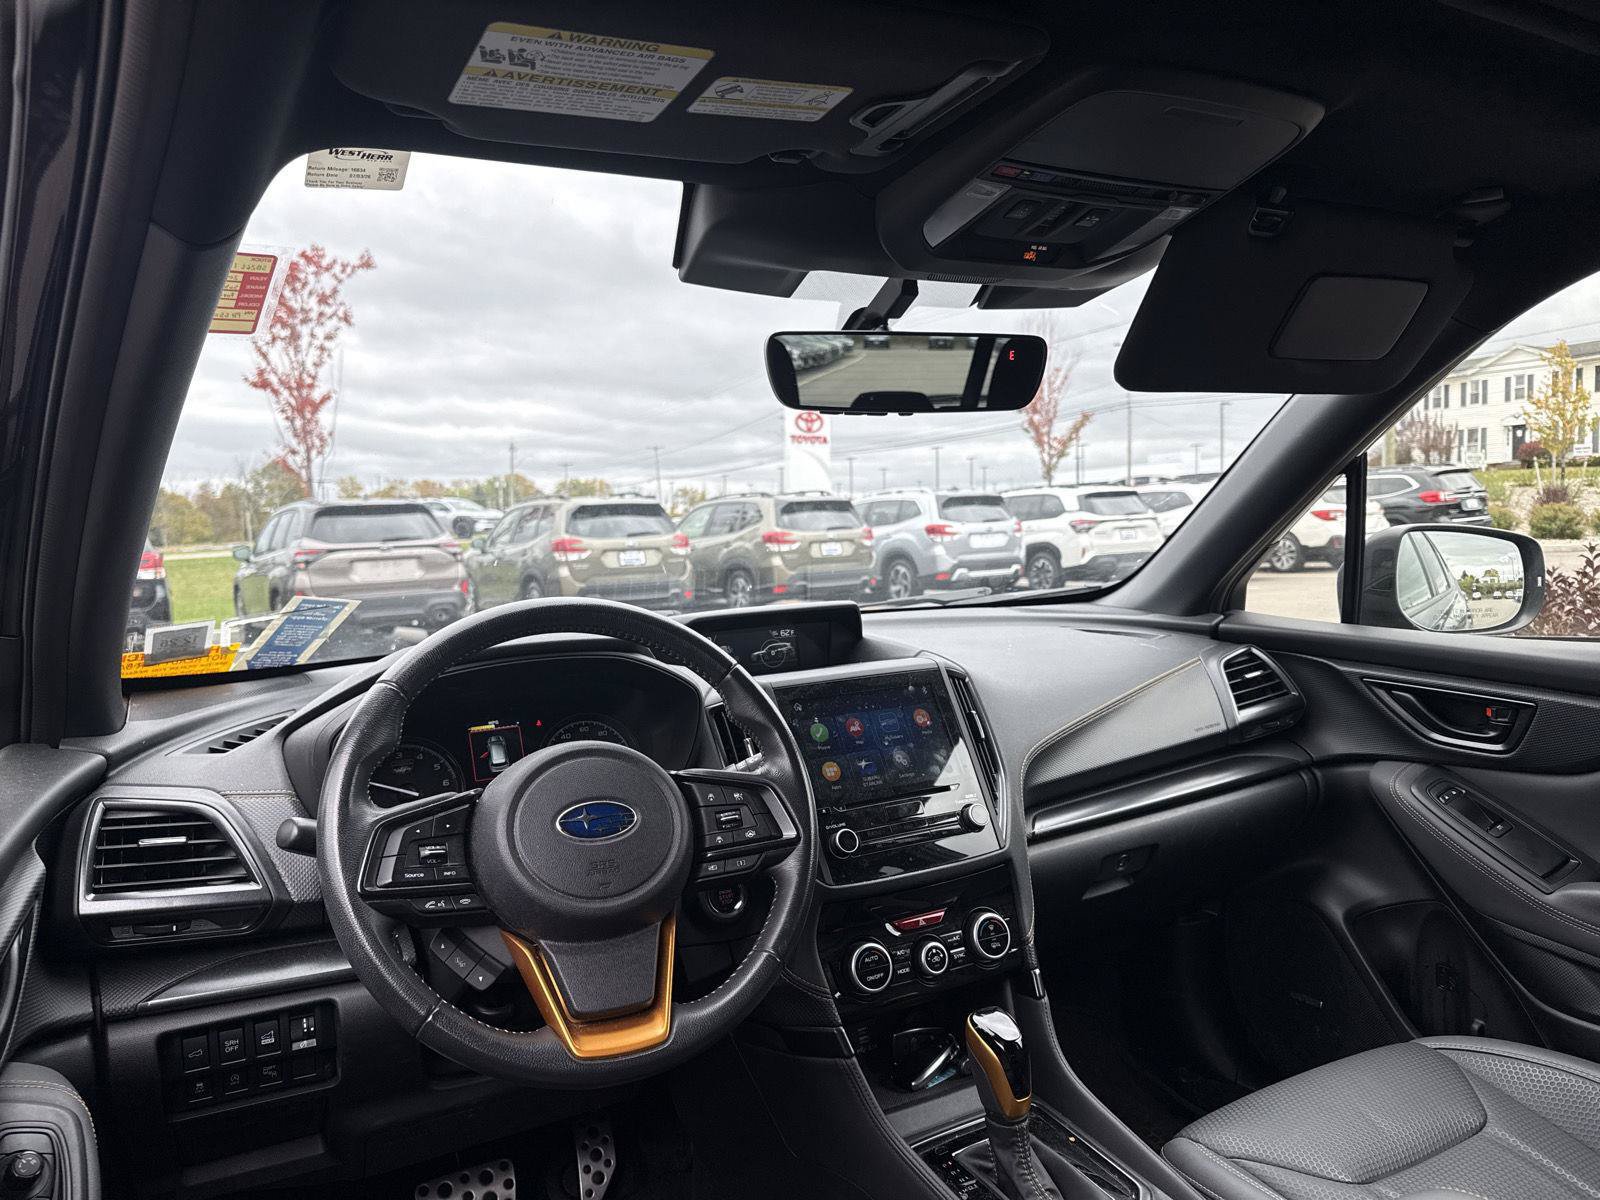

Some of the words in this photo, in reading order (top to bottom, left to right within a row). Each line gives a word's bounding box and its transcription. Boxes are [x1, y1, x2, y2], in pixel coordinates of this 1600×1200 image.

[567, 33, 660, 52] WARNING
[510, 36, 543, 47] EVEN
[545, 40, 575, 50] WITH
[575, 45, 635, 58] ADVANCED
[637, 52, 657, 61] AIR
[658, 54, 687, 64] BAGS
[502, 71, 660, 96] AVERTISSEMENT
[1009, 350, 1015, 361] E
[790, 435, 828, 444] TOYOTA
[434, 763, 441, 771] 5
[864, 955, 879, 963] AUTO
[224, 1039, 239, 1047] SRH
[224, 1045, 239, 1053] OFF
